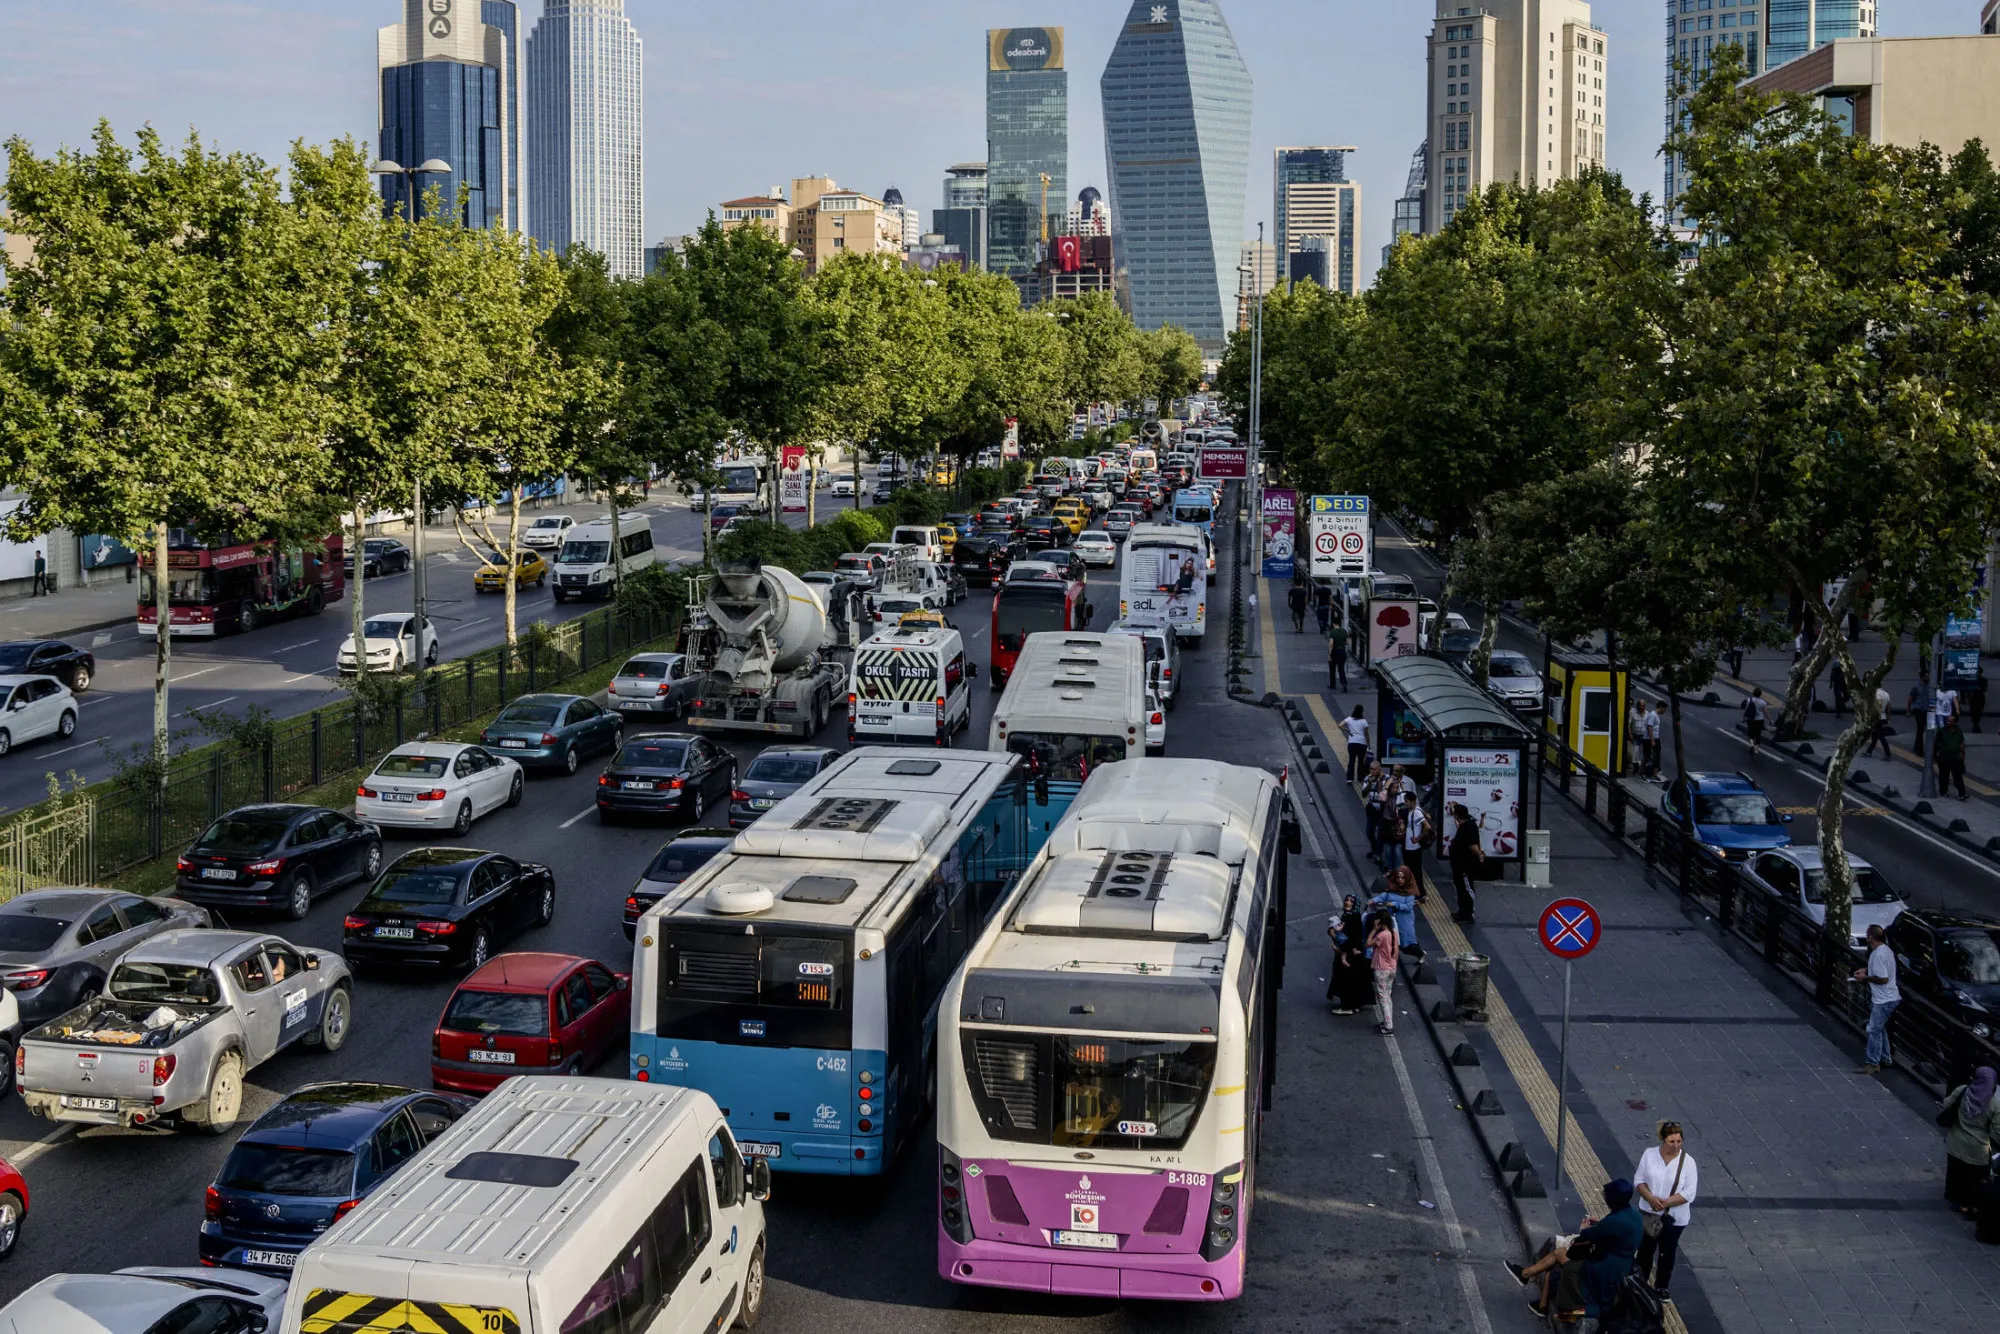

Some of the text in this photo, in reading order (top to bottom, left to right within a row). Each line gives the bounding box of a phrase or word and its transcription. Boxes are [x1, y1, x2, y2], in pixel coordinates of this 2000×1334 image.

[1007, 46, 1047, 57] odeabank
[1203, 453, 1244, 461] MEMORIAL
[785, 473, 803, 482] HAYAT
[785, 481, 802, 490] SANA
[1264, 498, 1295, 511] AREL
[1333, 498, 1365, 510] EDS
[1320, 538, 1334, 549] 70
[1345, 538, 1360, 549] 60
[865, 666, 892, 677] OKUL
[1450, 754, 1494, 764] etstur
[809, 965, 824, 974] 153
[138, 1060, 150, 1073] 61
[816, 1056, 847, 1072] C-462
[86, 1098, 95, 1108] TY
[1129, 1125, 1147, 1134] 153
[1168, 1172, 1206, 1186] B-1808
[247, 1250, 258, 1261] 34
[261, 1251, 273, 1263] PY
[482, 1313, 501, 1331] 10
